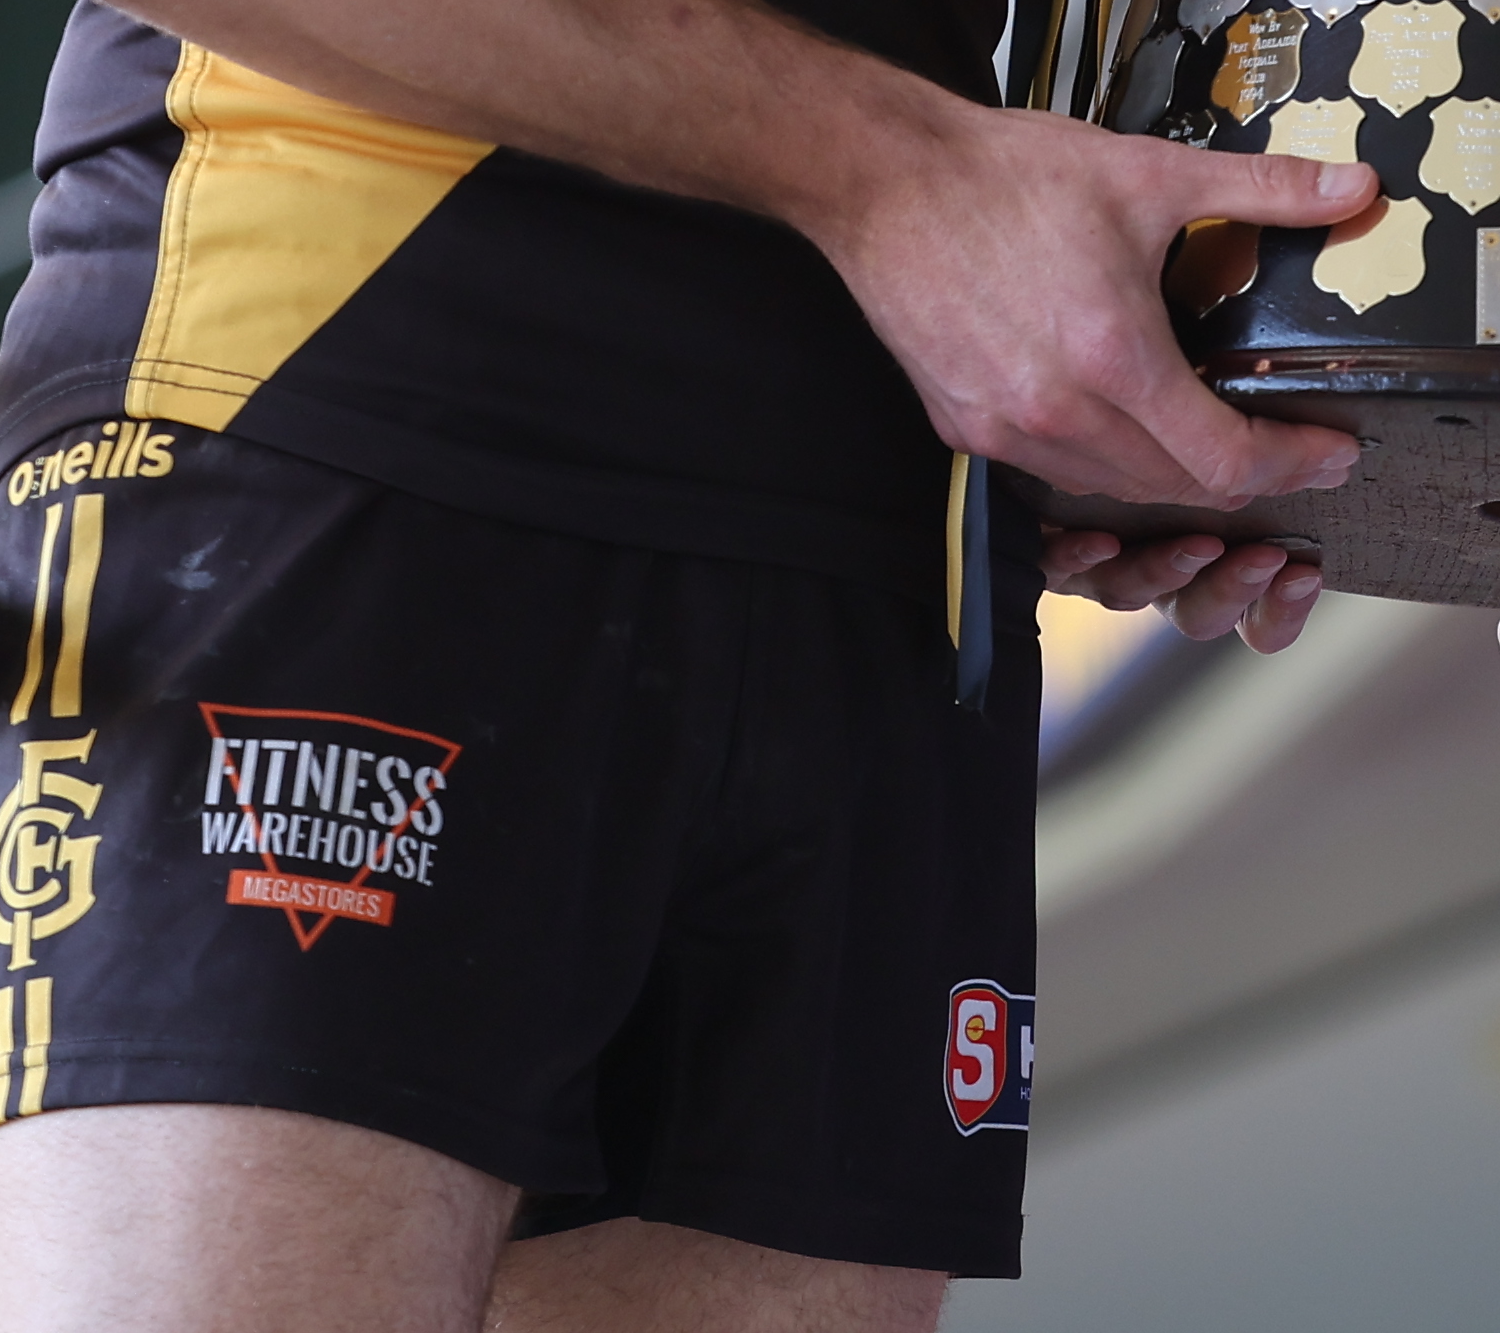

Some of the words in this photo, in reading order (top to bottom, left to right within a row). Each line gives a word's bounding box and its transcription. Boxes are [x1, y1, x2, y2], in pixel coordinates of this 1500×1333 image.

[204, 736, 447, 836] FITNESS
[202, 810, 439, 887] WAREHOUSE
[242, 876, 382, 919] MEGASTORES
